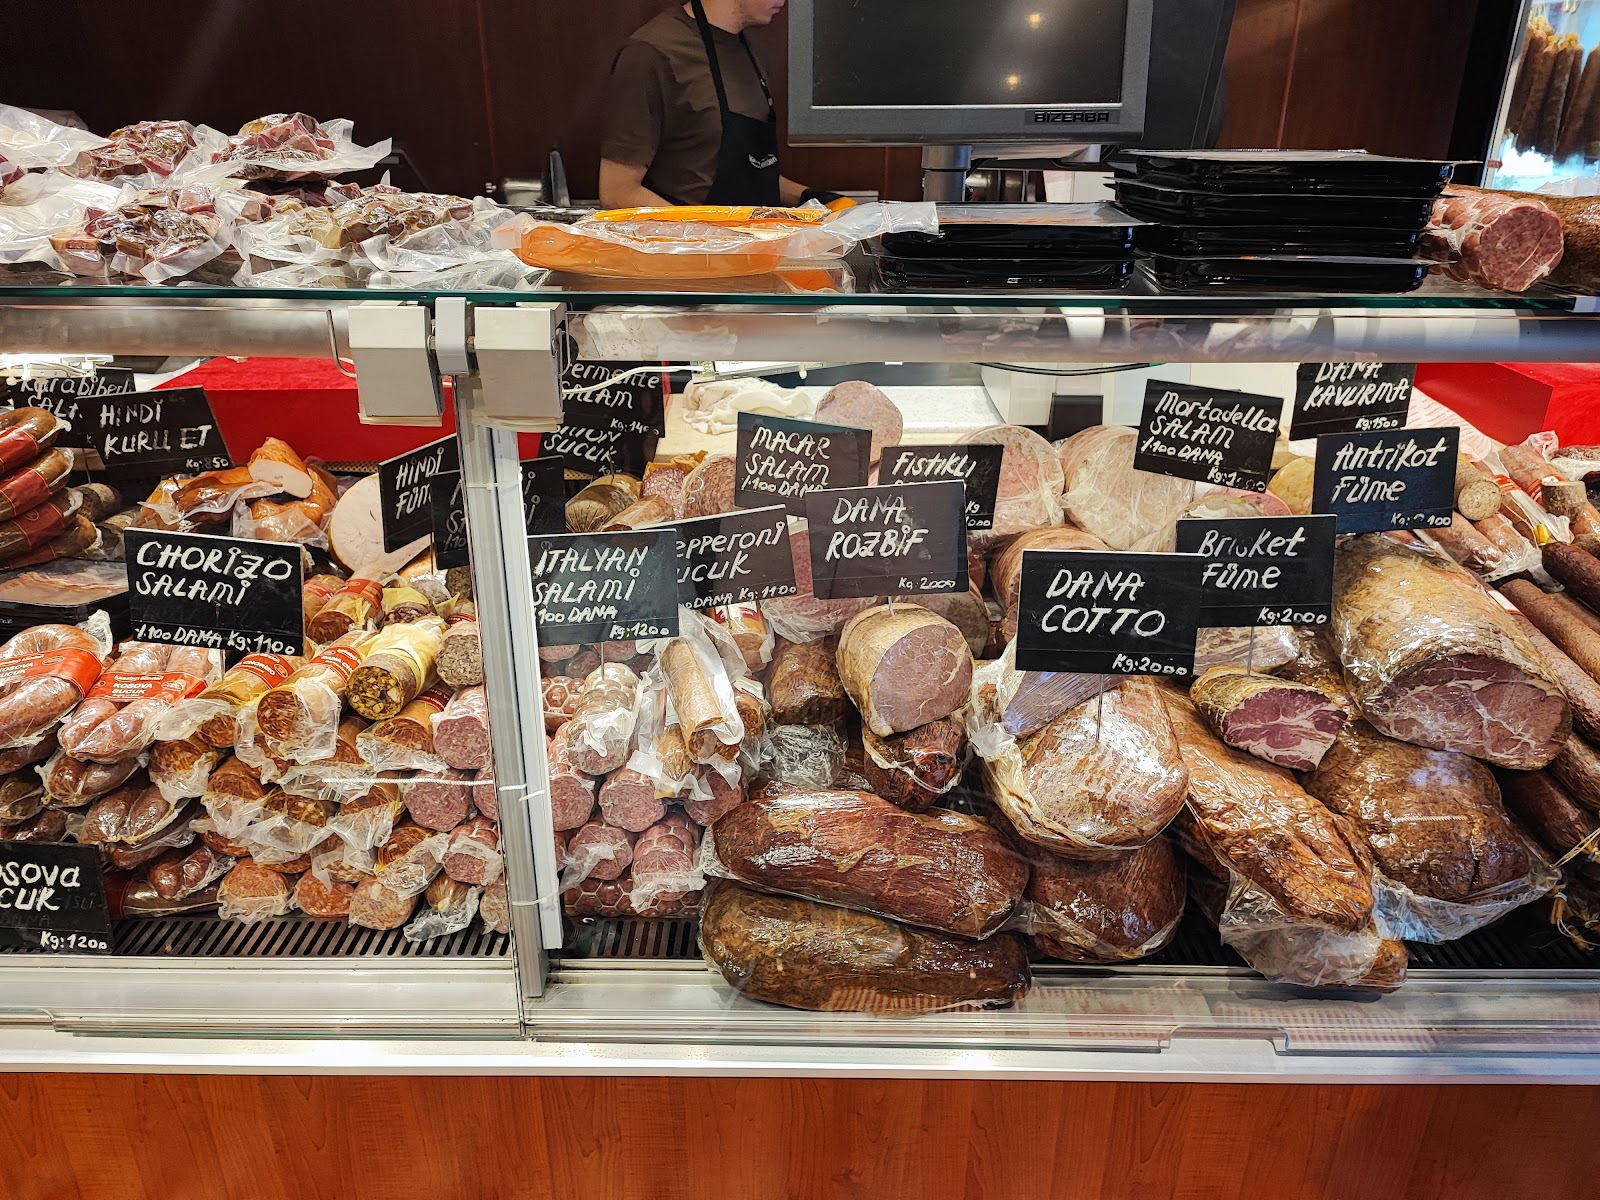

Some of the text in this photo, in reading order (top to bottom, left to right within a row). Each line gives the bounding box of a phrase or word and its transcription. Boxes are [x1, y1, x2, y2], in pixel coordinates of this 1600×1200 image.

[1034, 110, 1110, 123] BIZERBA
[570, 361, 660, 390] ermente
[1314, 362, 1383, 384] DANA
[1154, 390, 1278, 433] Mortadella
[1303, 378, 1410, 412] KAVURMA
[103, 425, 212, 460] KURU ET
[750, 426, 831, 460] MACAR
[1150, 415, 1235, 449] SALAM
[745, 453, 830, 486] SALAM
[1178, 444, 1224, 465] DANA
[832, 494, 907, 526] DANA
[1045, 568, 1146, 602] DANA
[1201, 562, 1281, 590] Füme
[567, 604, 619, 624] DANA
[1041, 604, 1166, 637] COTTO
